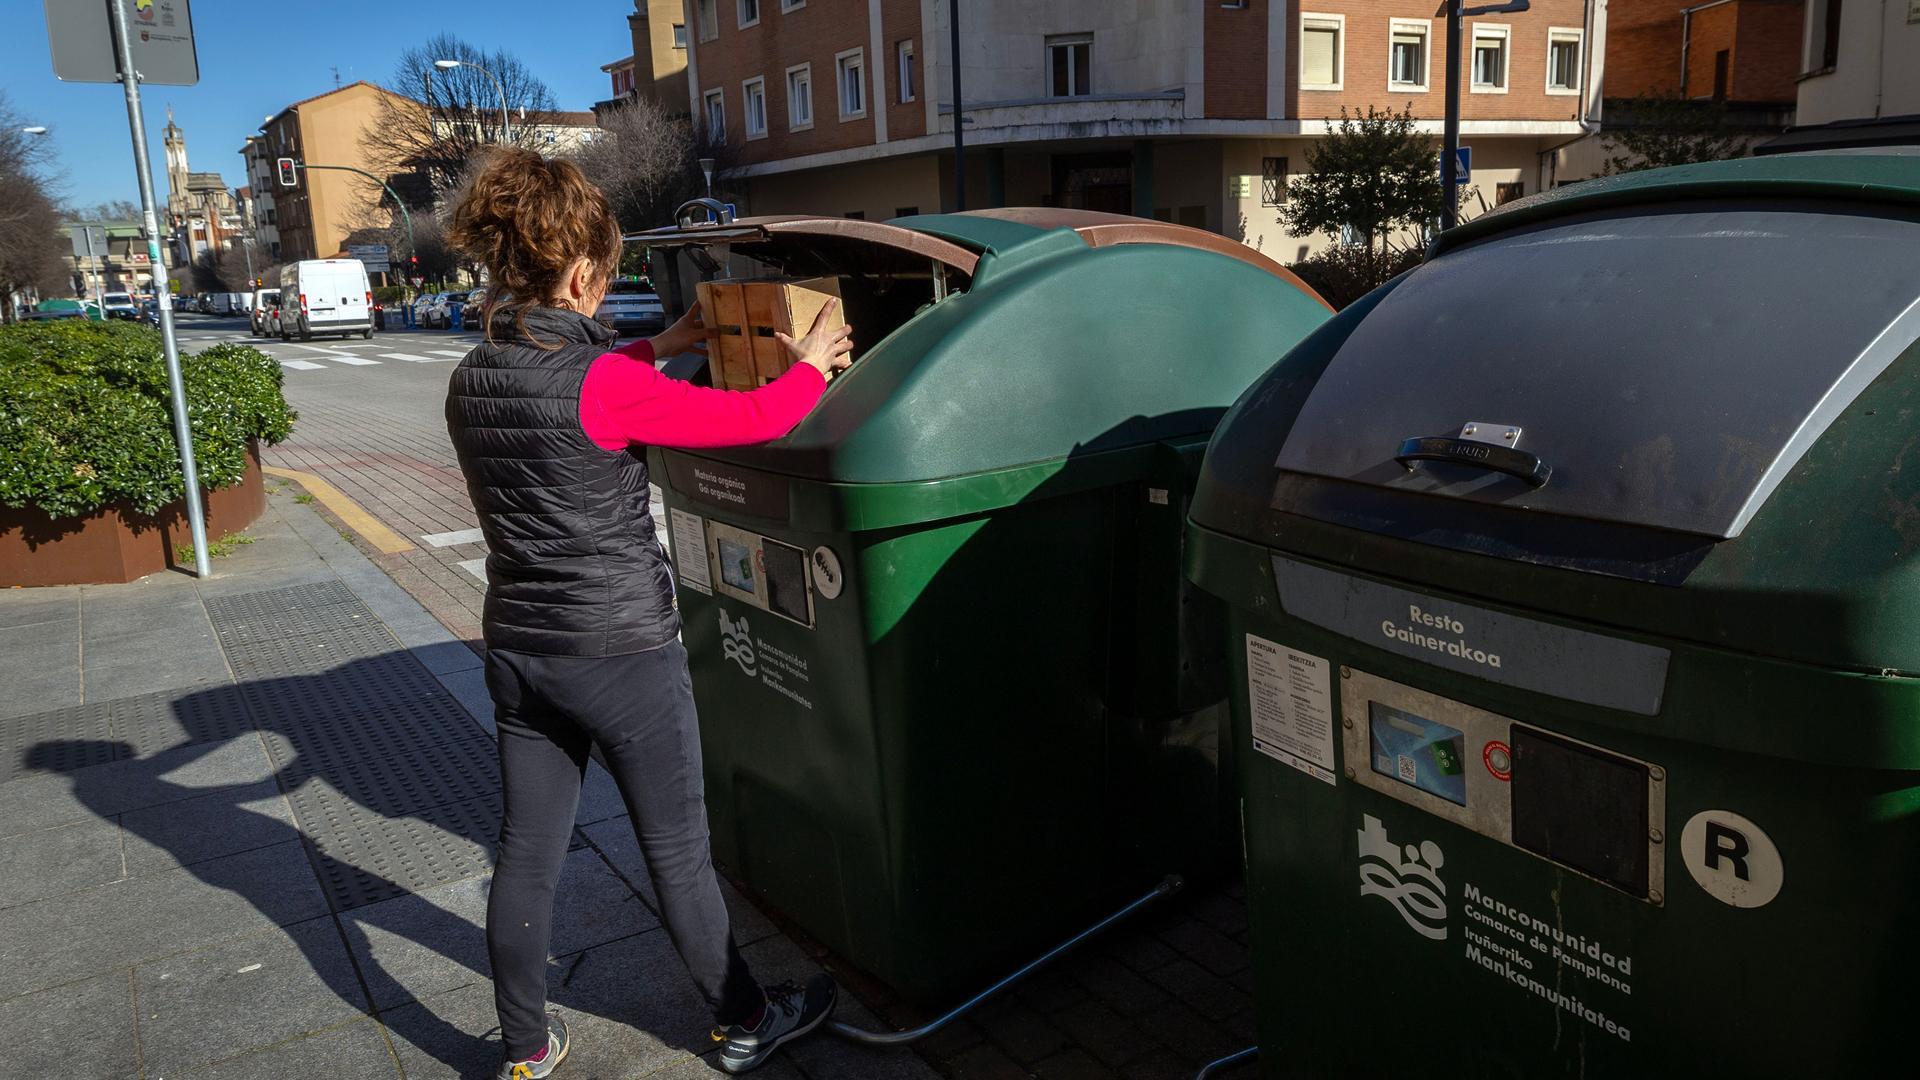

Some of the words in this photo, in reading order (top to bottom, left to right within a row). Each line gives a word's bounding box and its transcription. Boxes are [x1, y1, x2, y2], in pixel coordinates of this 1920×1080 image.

[1382, 620, 1501, 668] Gainerakoa
[1409, 605, 1464, 634] Resto
[1250, 641, 1277, 655] APERTURA
[1704, 822, 1750, 882] R
[1464, 883, 1631, 976] Mancomunidad
[1464, 927, 1533, 970] Iruñerriko
[1464, 904, 1525, 943] Comarca
[1529, 933, 1549, 954] de
[1552, 946, 1631, 996] Pamplona
[1465, 943, 1631, 1042] Mankomunitatea
